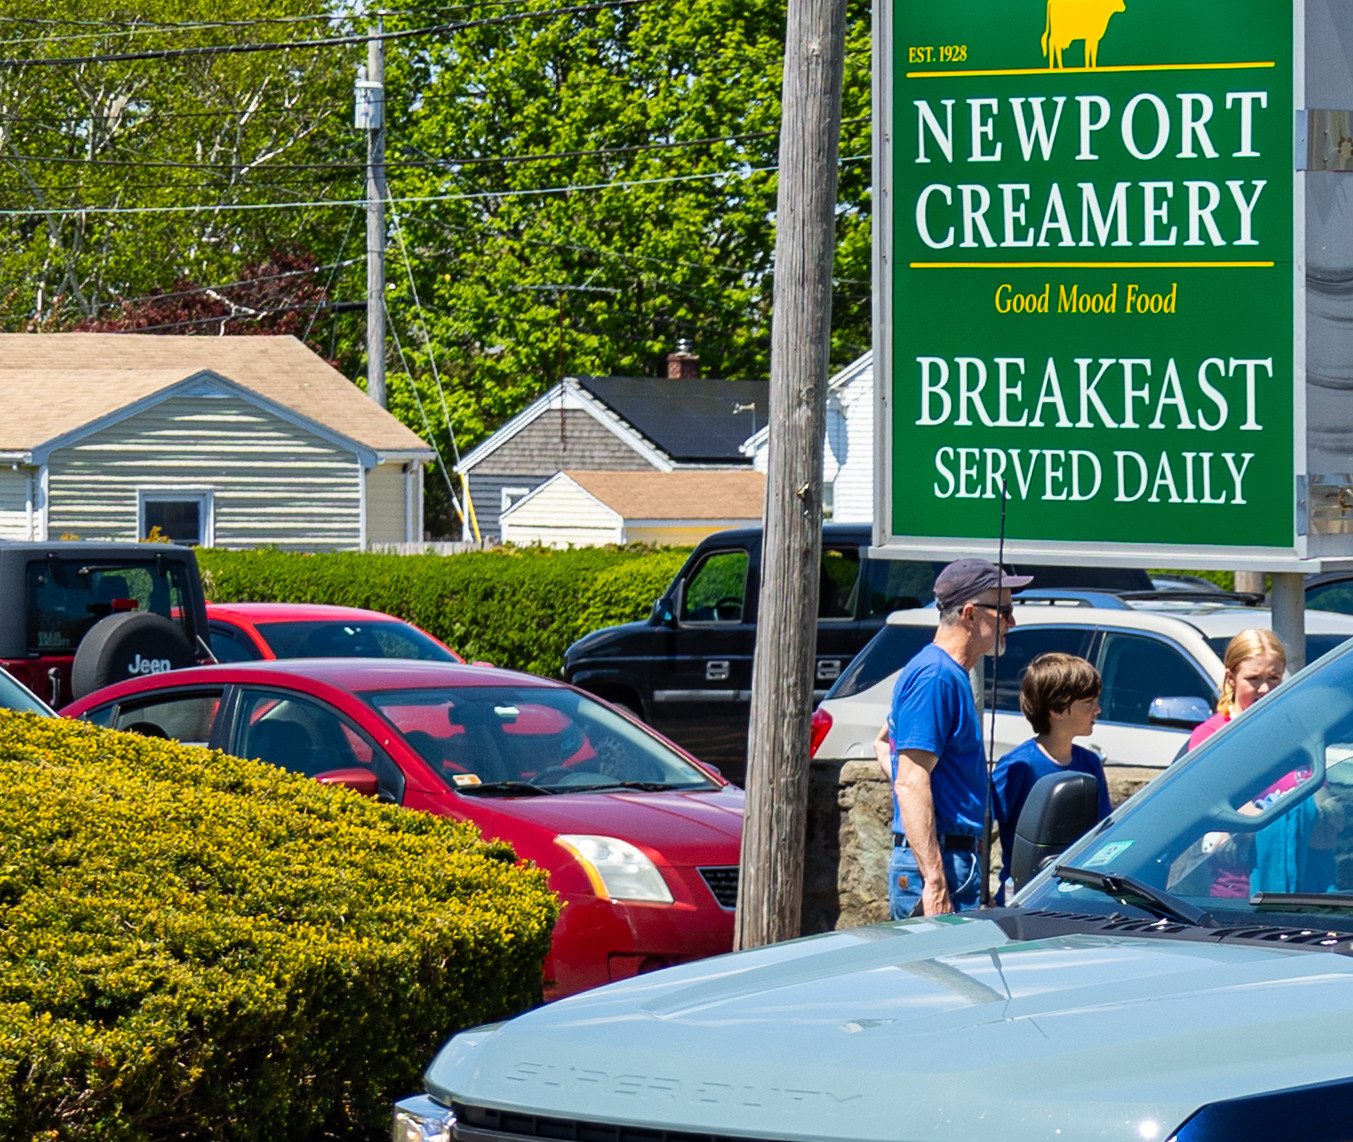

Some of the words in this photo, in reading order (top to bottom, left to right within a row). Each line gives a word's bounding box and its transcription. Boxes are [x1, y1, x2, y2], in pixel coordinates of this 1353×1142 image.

[909, 46, 936, 63] EST.
[939, 45, 968, 62] 1928
[913, 91, 1268, 164] NEWPORT
[915, 179, 1268, 250] CREAMERY
[994, 284, 1050, 314] Good
[1056, 283, 1118, 314] Mood
[1125, 282, 1178, 314] Food
[915, 356, 1274, 432] BREAKFAST
[933, 446, 1103, 503] SERVED
[1113, 449, 1255, 505] DAILY
[128, 654, 171, 674] Jeep
